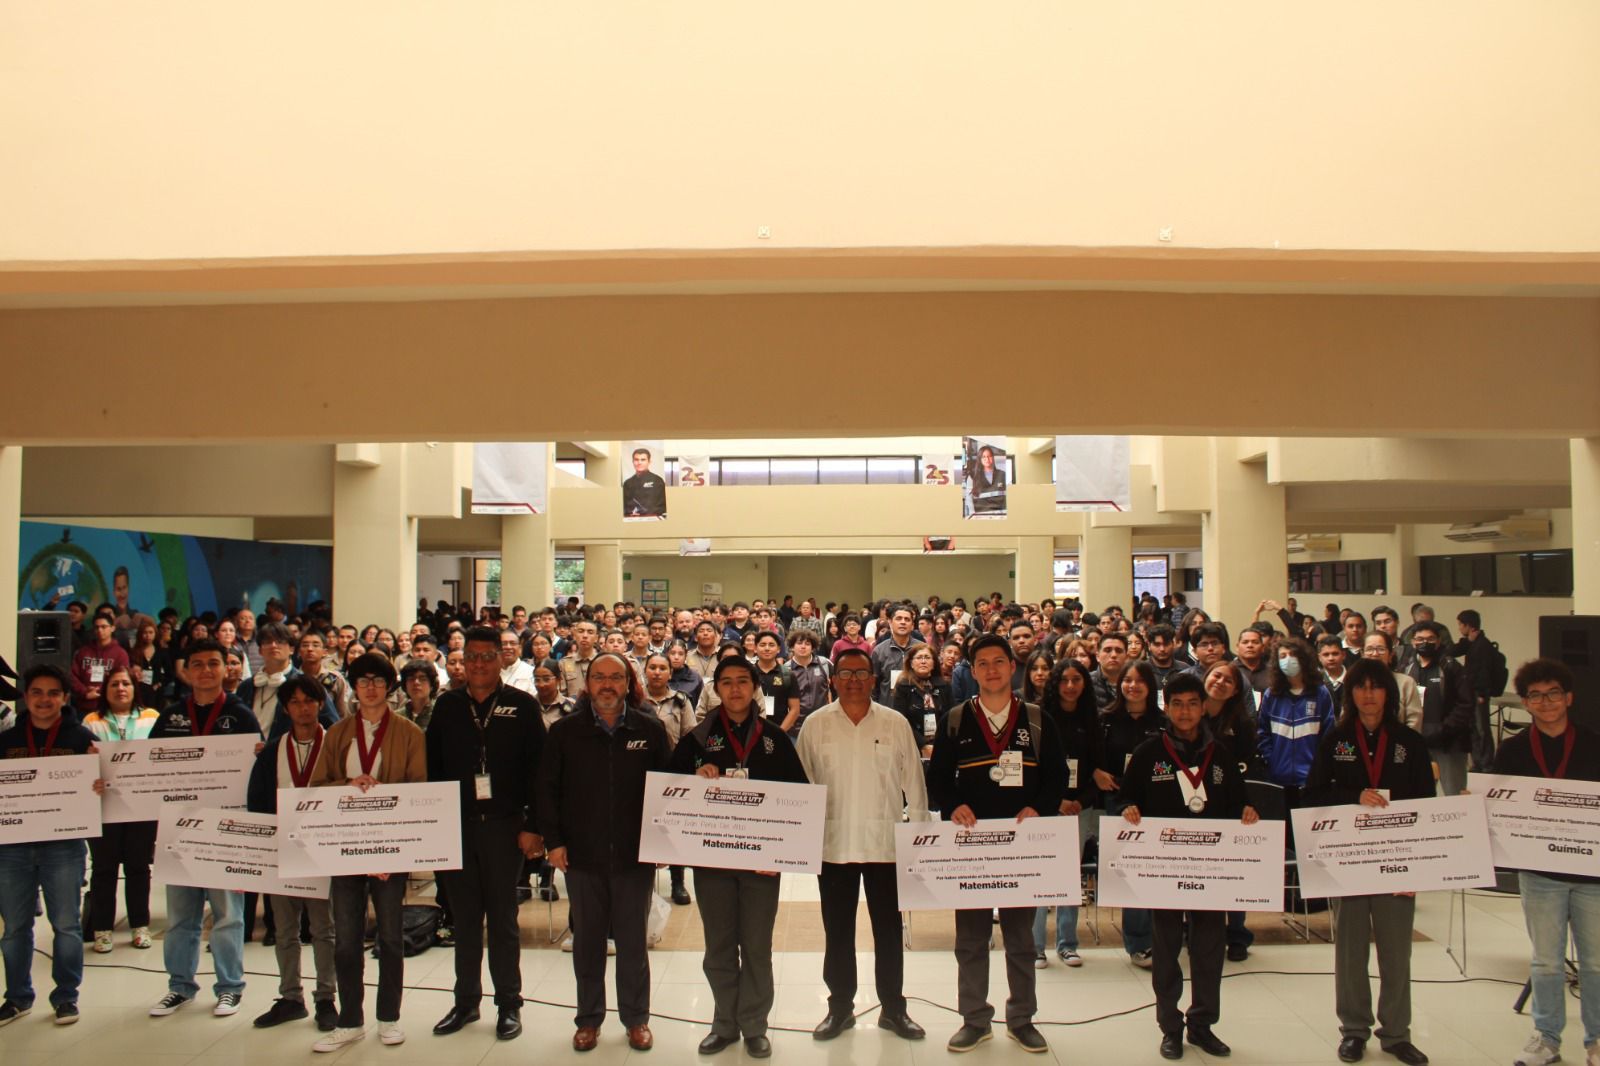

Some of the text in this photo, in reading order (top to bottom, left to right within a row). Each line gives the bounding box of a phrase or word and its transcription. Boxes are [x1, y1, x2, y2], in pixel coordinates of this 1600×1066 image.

[682, 467, 704, 486] 25
[926, 465, 949, 485] 25
[494, 706, 517, 714] UTT
[111, 752, 136, 762] UTT
[662, 786, 690, 798] UTT
[1487, 788, 1517, 800] UTT
[163, 793, 198, 802] Química
[295, 800, 323, 811] UTT
[176, 818, 204, 828] UTT
[1310, 819, 1339, 831] UTT
[912, 835, 940, 845] UTT
[1117, 831, 1144, 840] UTT
[703, 838, 762, 851] Matemáticas
[1548, 843, 1592, 855] Química
[341, 845, 400, 856] Matemáticas
[225, 866, 262, 876] Química
[1380, 864, 1409, 874] Física
[959, 880, 1019, 890] Matemáticas
[1178, 882, 1205, 890] Física
